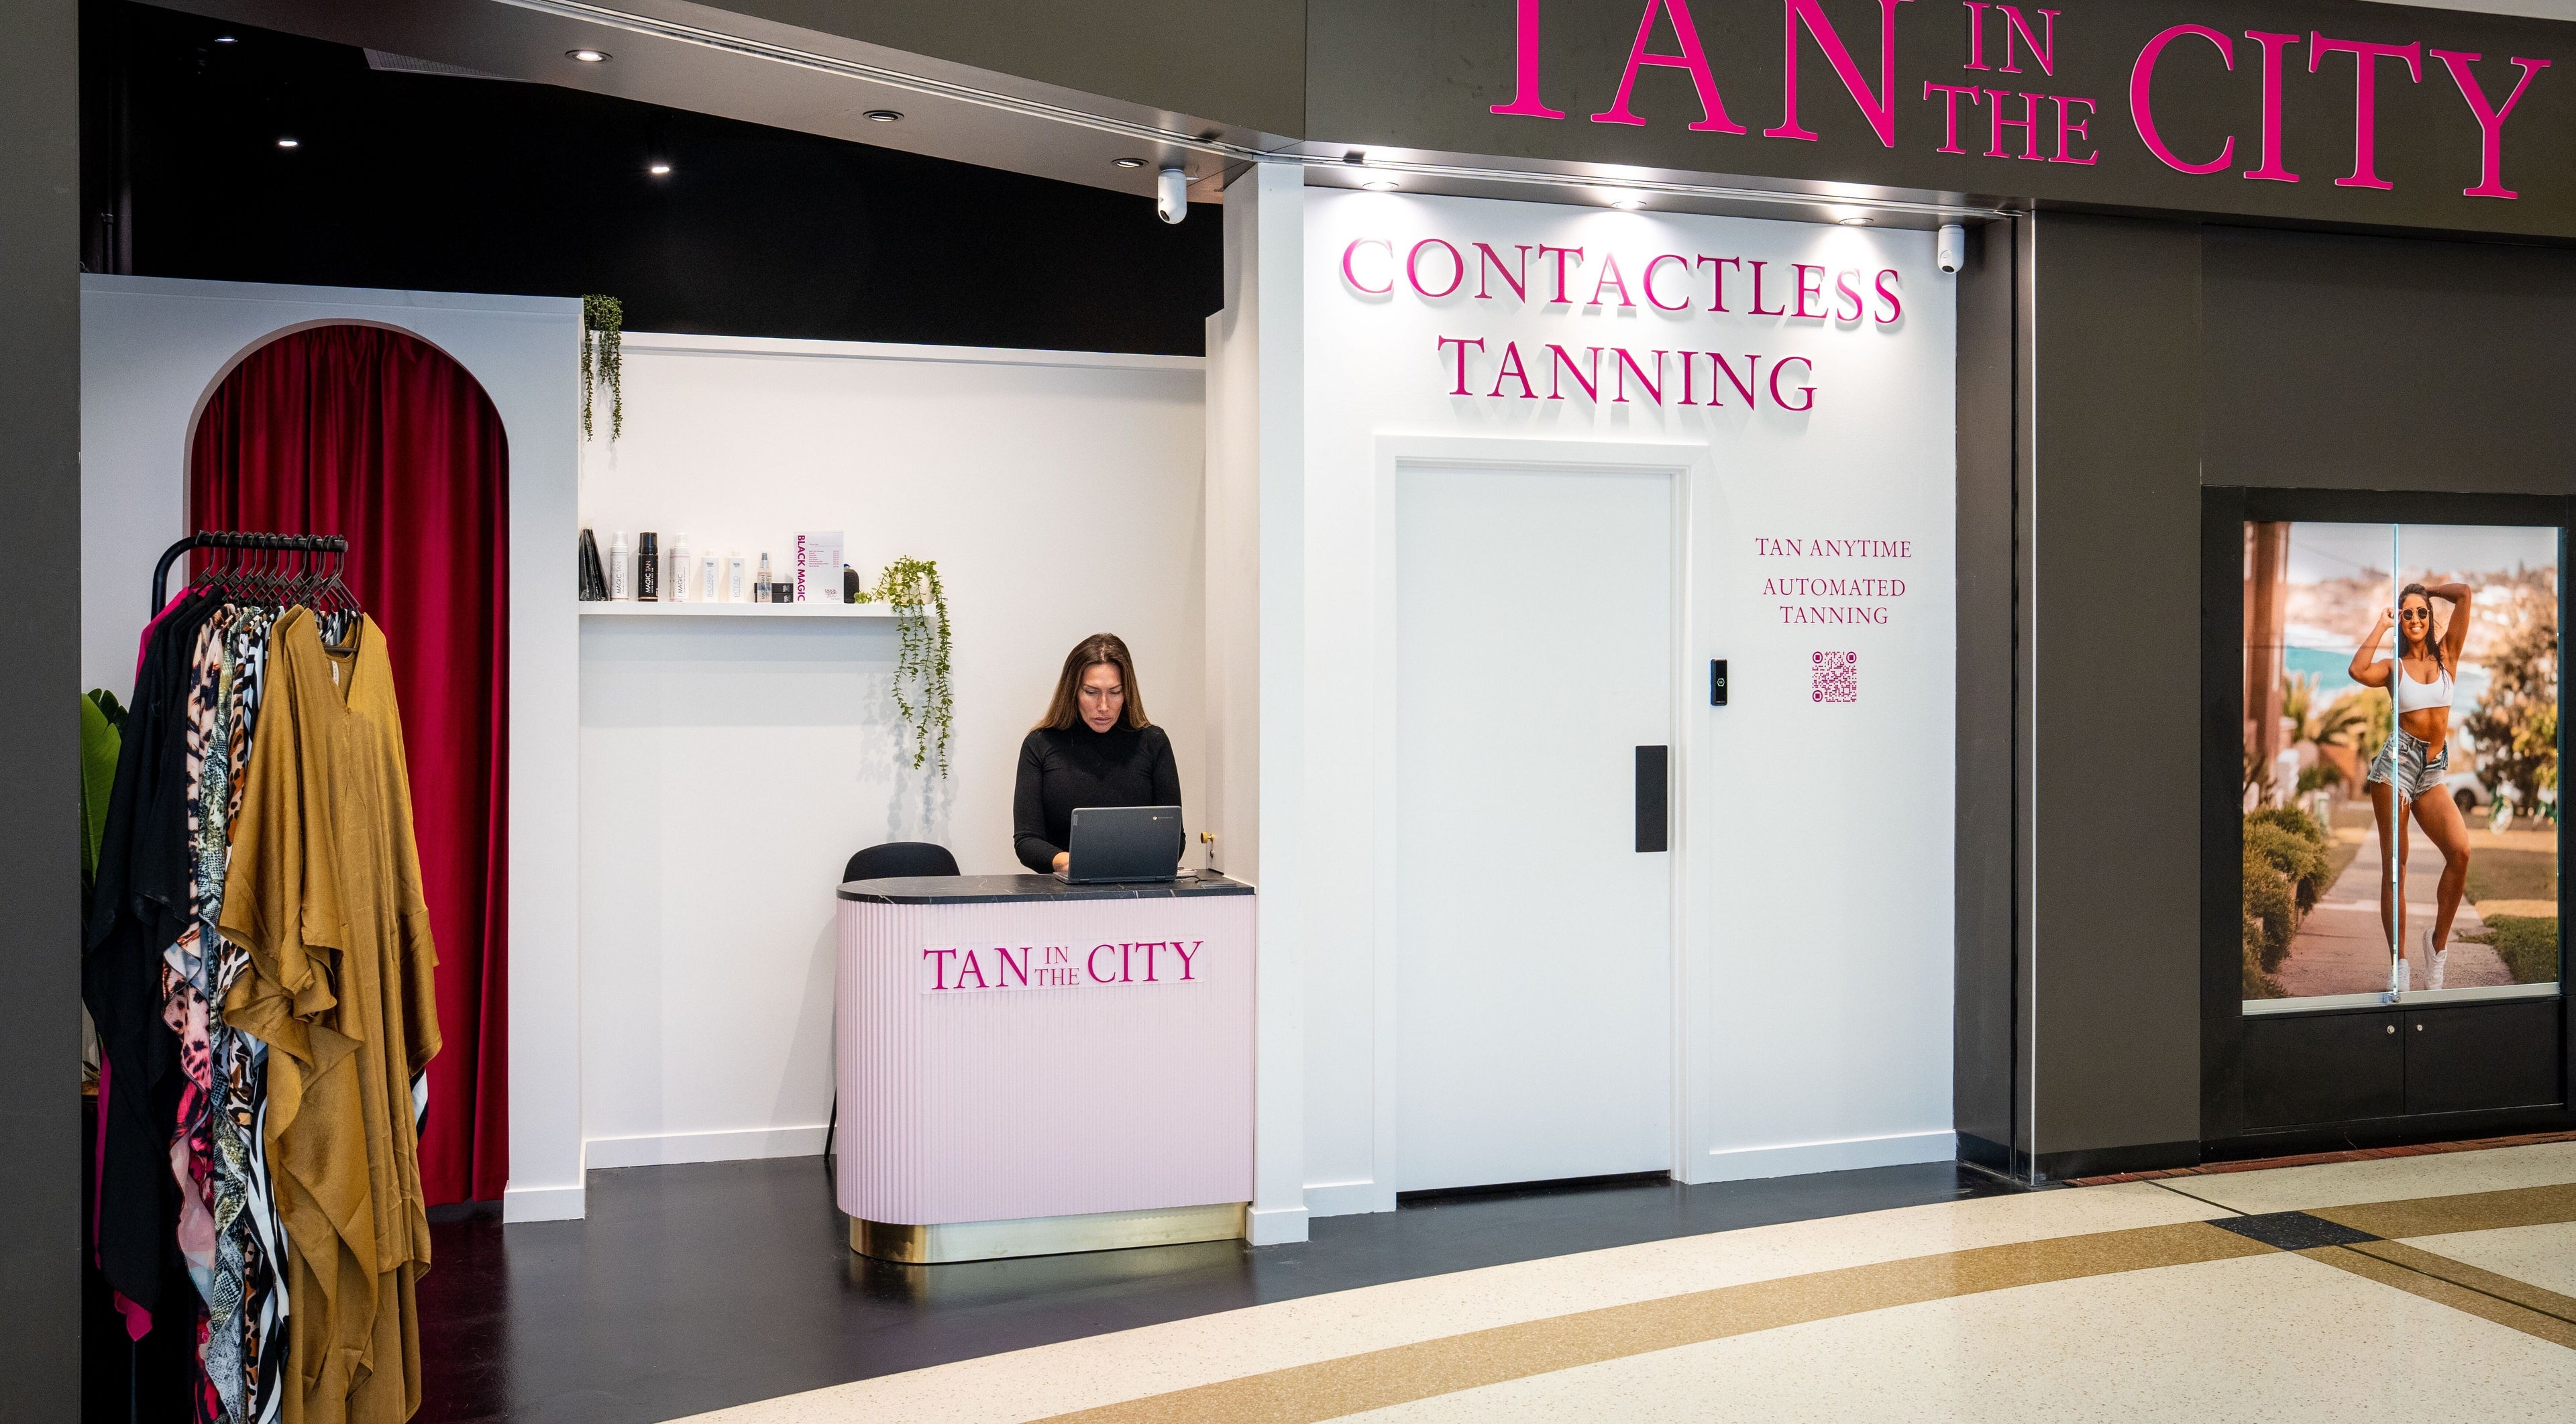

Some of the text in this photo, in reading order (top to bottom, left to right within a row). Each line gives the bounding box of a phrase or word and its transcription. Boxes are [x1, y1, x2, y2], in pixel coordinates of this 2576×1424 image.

[1962, 1, 2061, 76] IN
[1923, 79, 2100, 166] THE
[2130, 22, 2553, 201] CITY
[1342, 237, 1902, 325] CONTACTLESS
[1438, 335, 1818, 412] TANNING
[797, 535, 806, 601] BLACK MAGIC
[1755, 537, 1912, 558] TAN ANYTIME
[1762, 578, 1906, 597] AUTOMATED
[1780, 606, 1889, 624] TANNING
[923, 940, 1204, 991] TAN IN THE CITY
